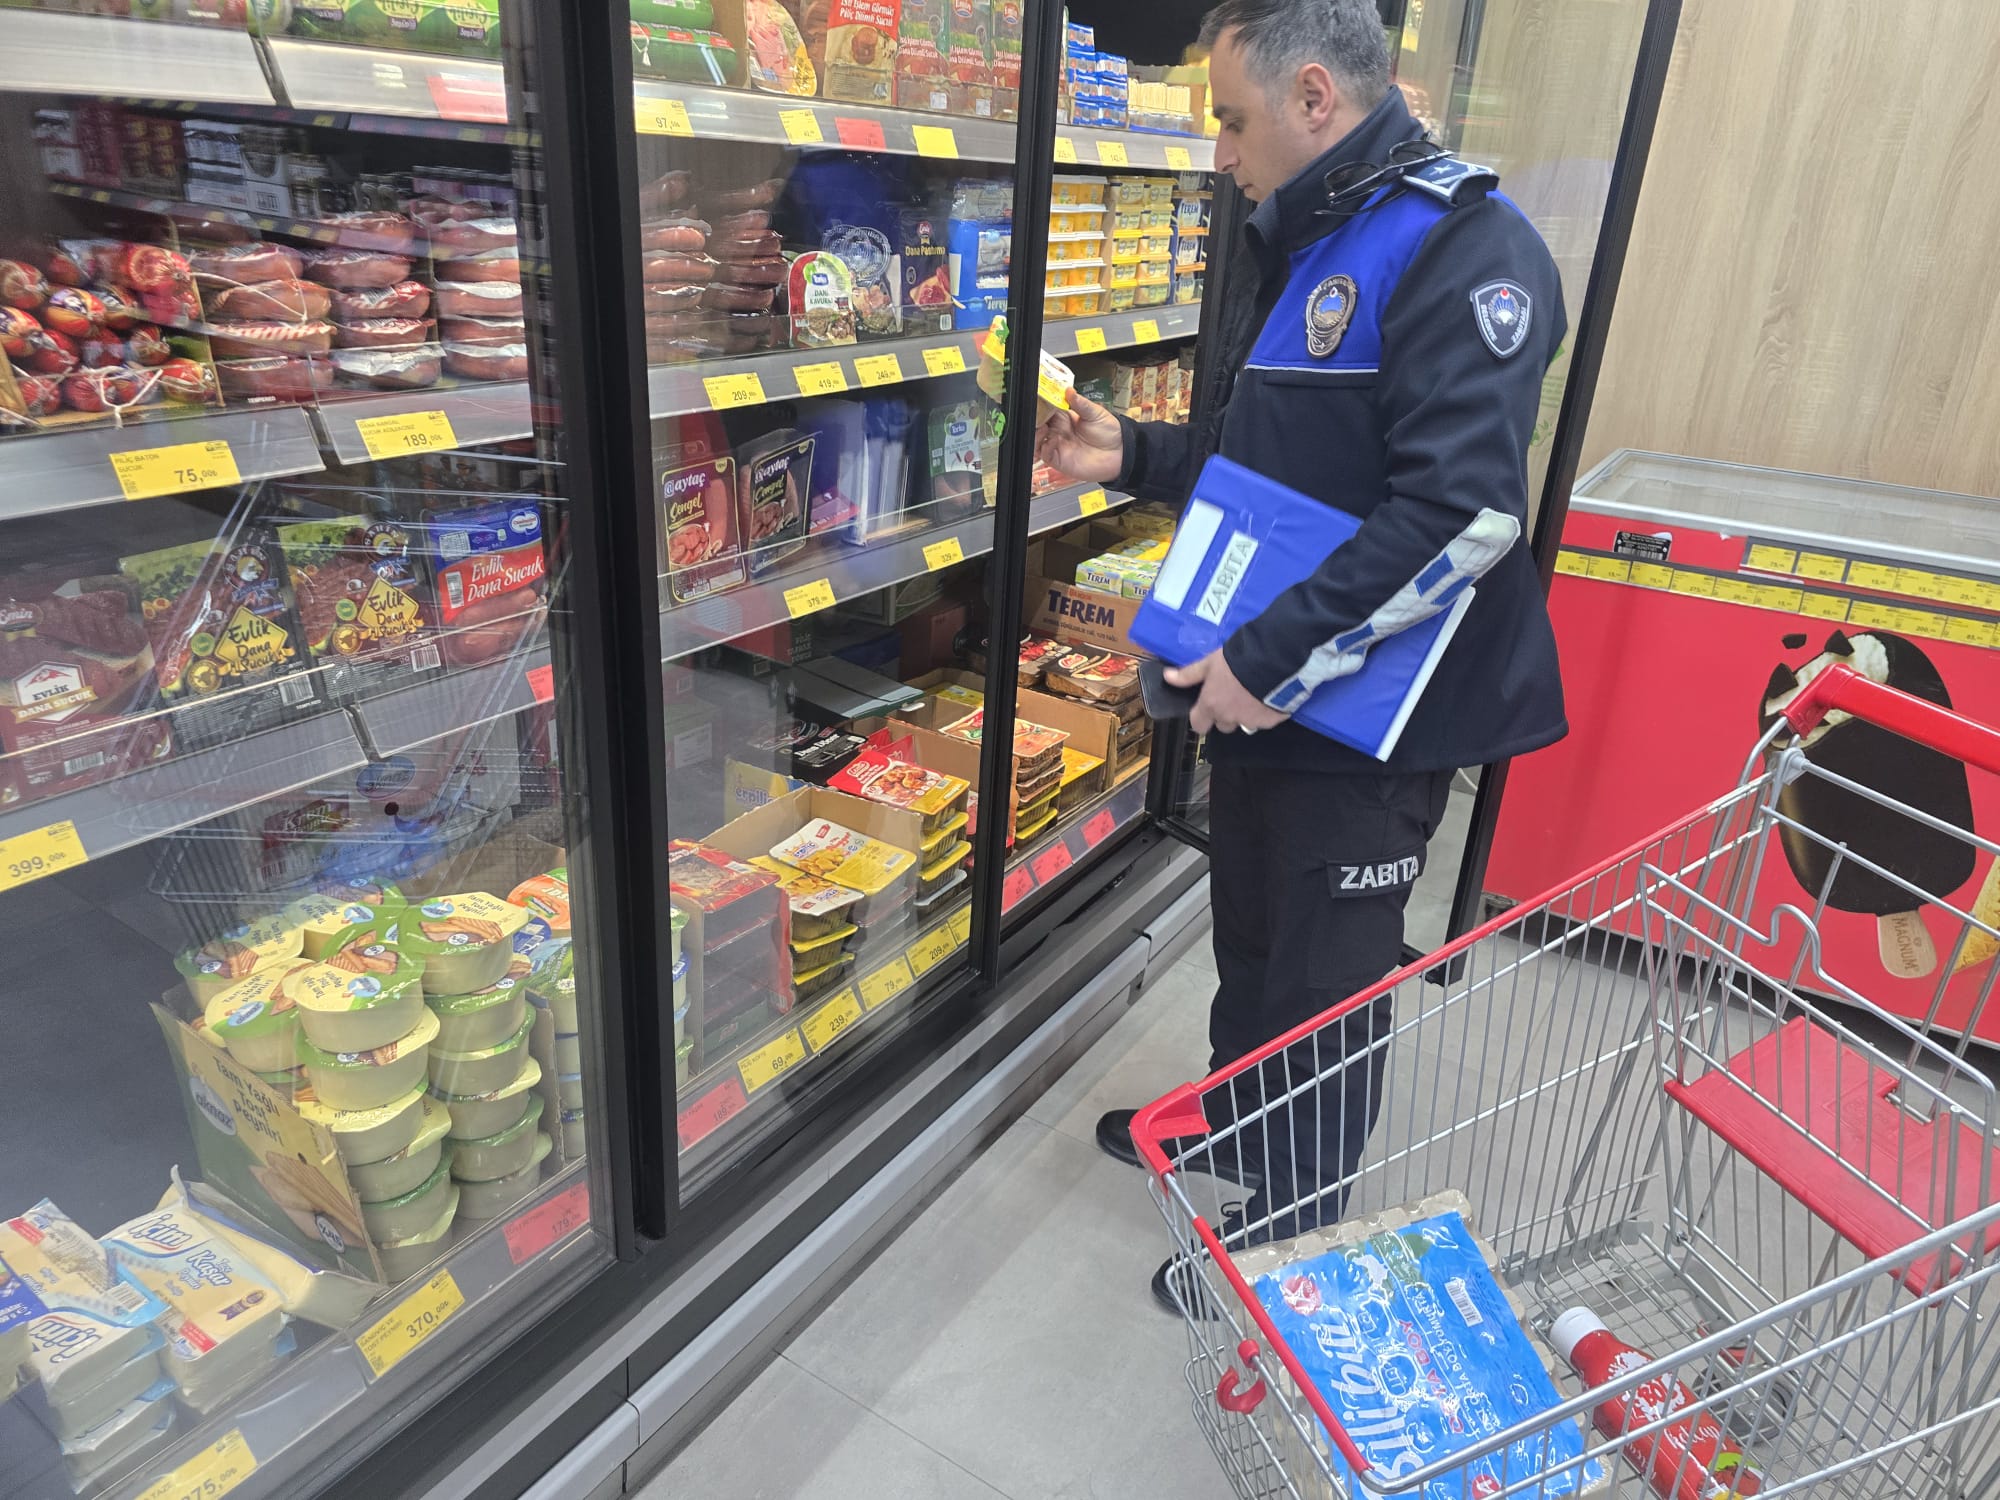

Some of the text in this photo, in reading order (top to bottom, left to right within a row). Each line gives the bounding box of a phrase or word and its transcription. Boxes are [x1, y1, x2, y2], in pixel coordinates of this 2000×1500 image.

[467, 555, 545, 602] Dana Sucuk
[1087, 572, 1110, 585] TEREM
[1203, 541, 1252, 617] ZABITA
[1048, 588, 1115, 628] TEREM
[18, 703, 53, 718] DANA
[33, 683, 70, 701] EVLİK
[1341, 856, 1419, 889] ZABITA
[1891, 917, 1917, 970] MAGNUM
[186, 1250, 233, 1287] Kaşar
